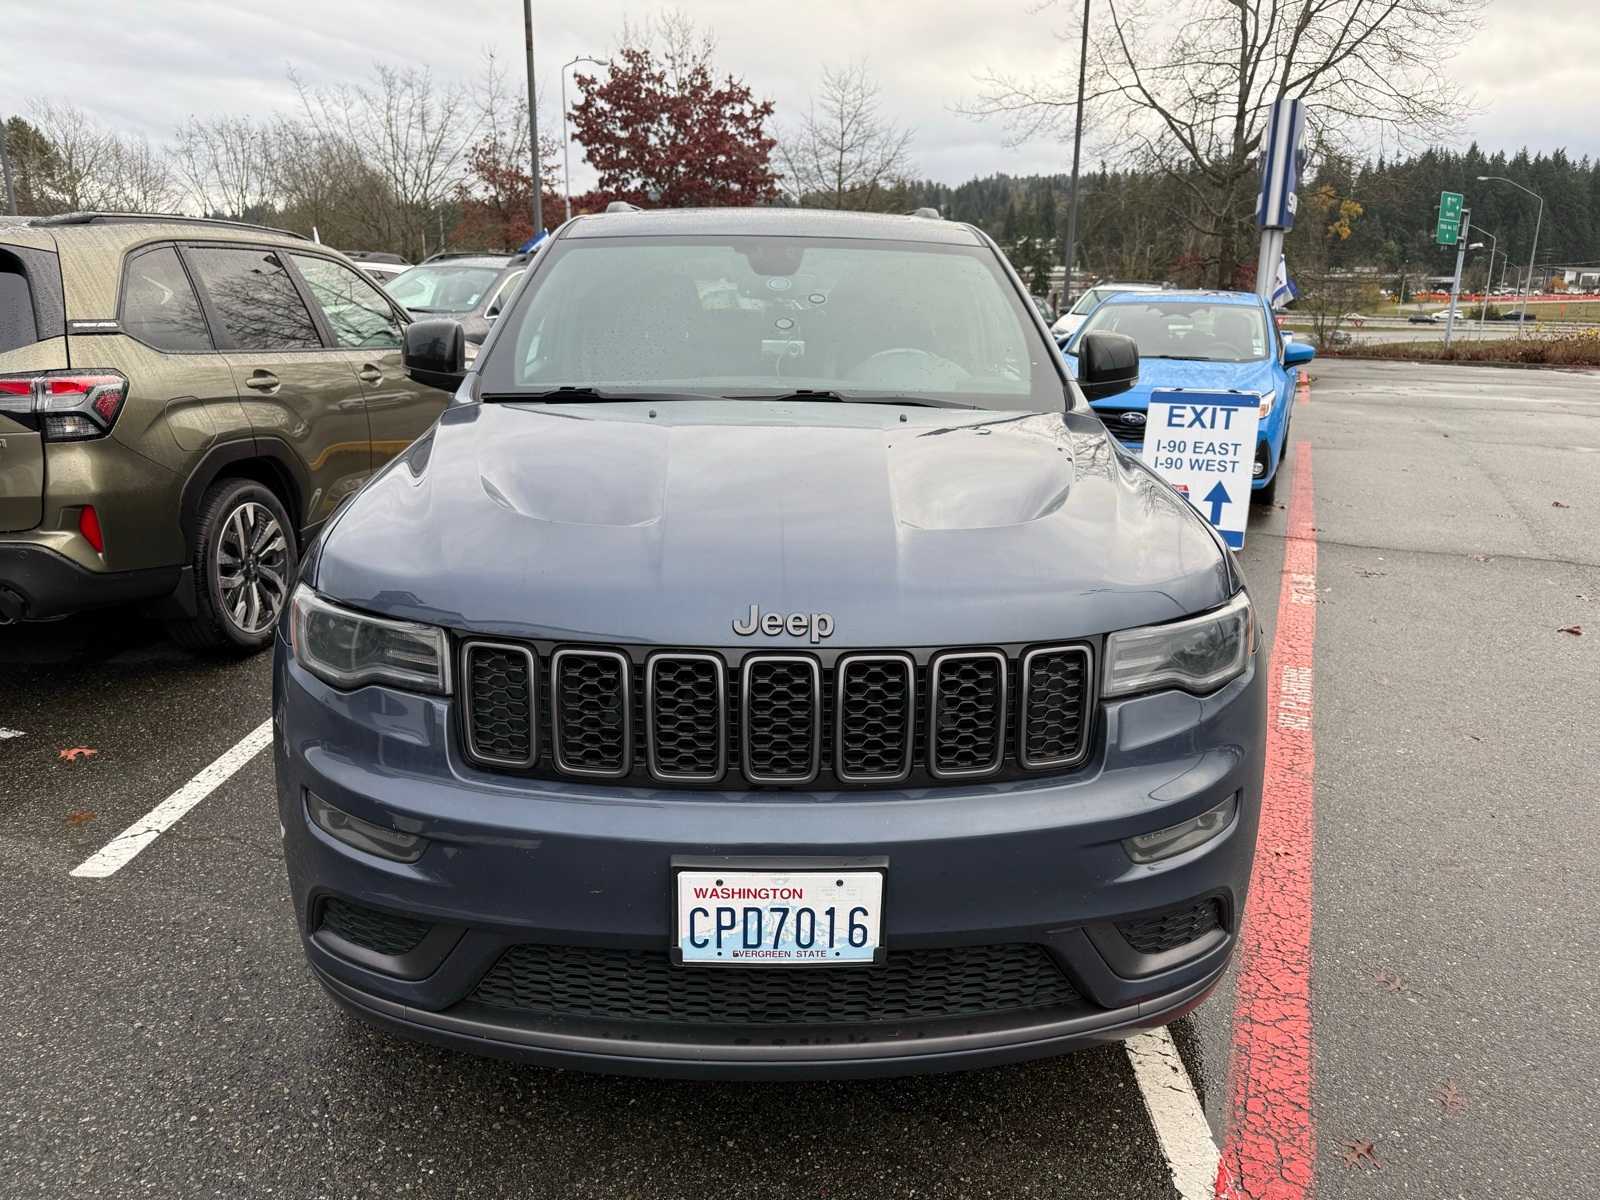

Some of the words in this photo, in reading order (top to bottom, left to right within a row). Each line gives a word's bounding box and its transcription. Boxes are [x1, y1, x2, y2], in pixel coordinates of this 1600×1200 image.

[1167, 405, 1238, 430] EXIT
[1156, 439, 1186, 454] I-90
[1192, 441, 1241, 457] EAST
[1154, 456, 1183, 470] I-90
[1189, 458, 1239, 473] WEST
[732, 604, 835, 643] Jeep
[694, 887, 803, 900] WASHINGTON
[689, 906, 869, 949] CPD7016
[796, 950, 827, 958] STATE
